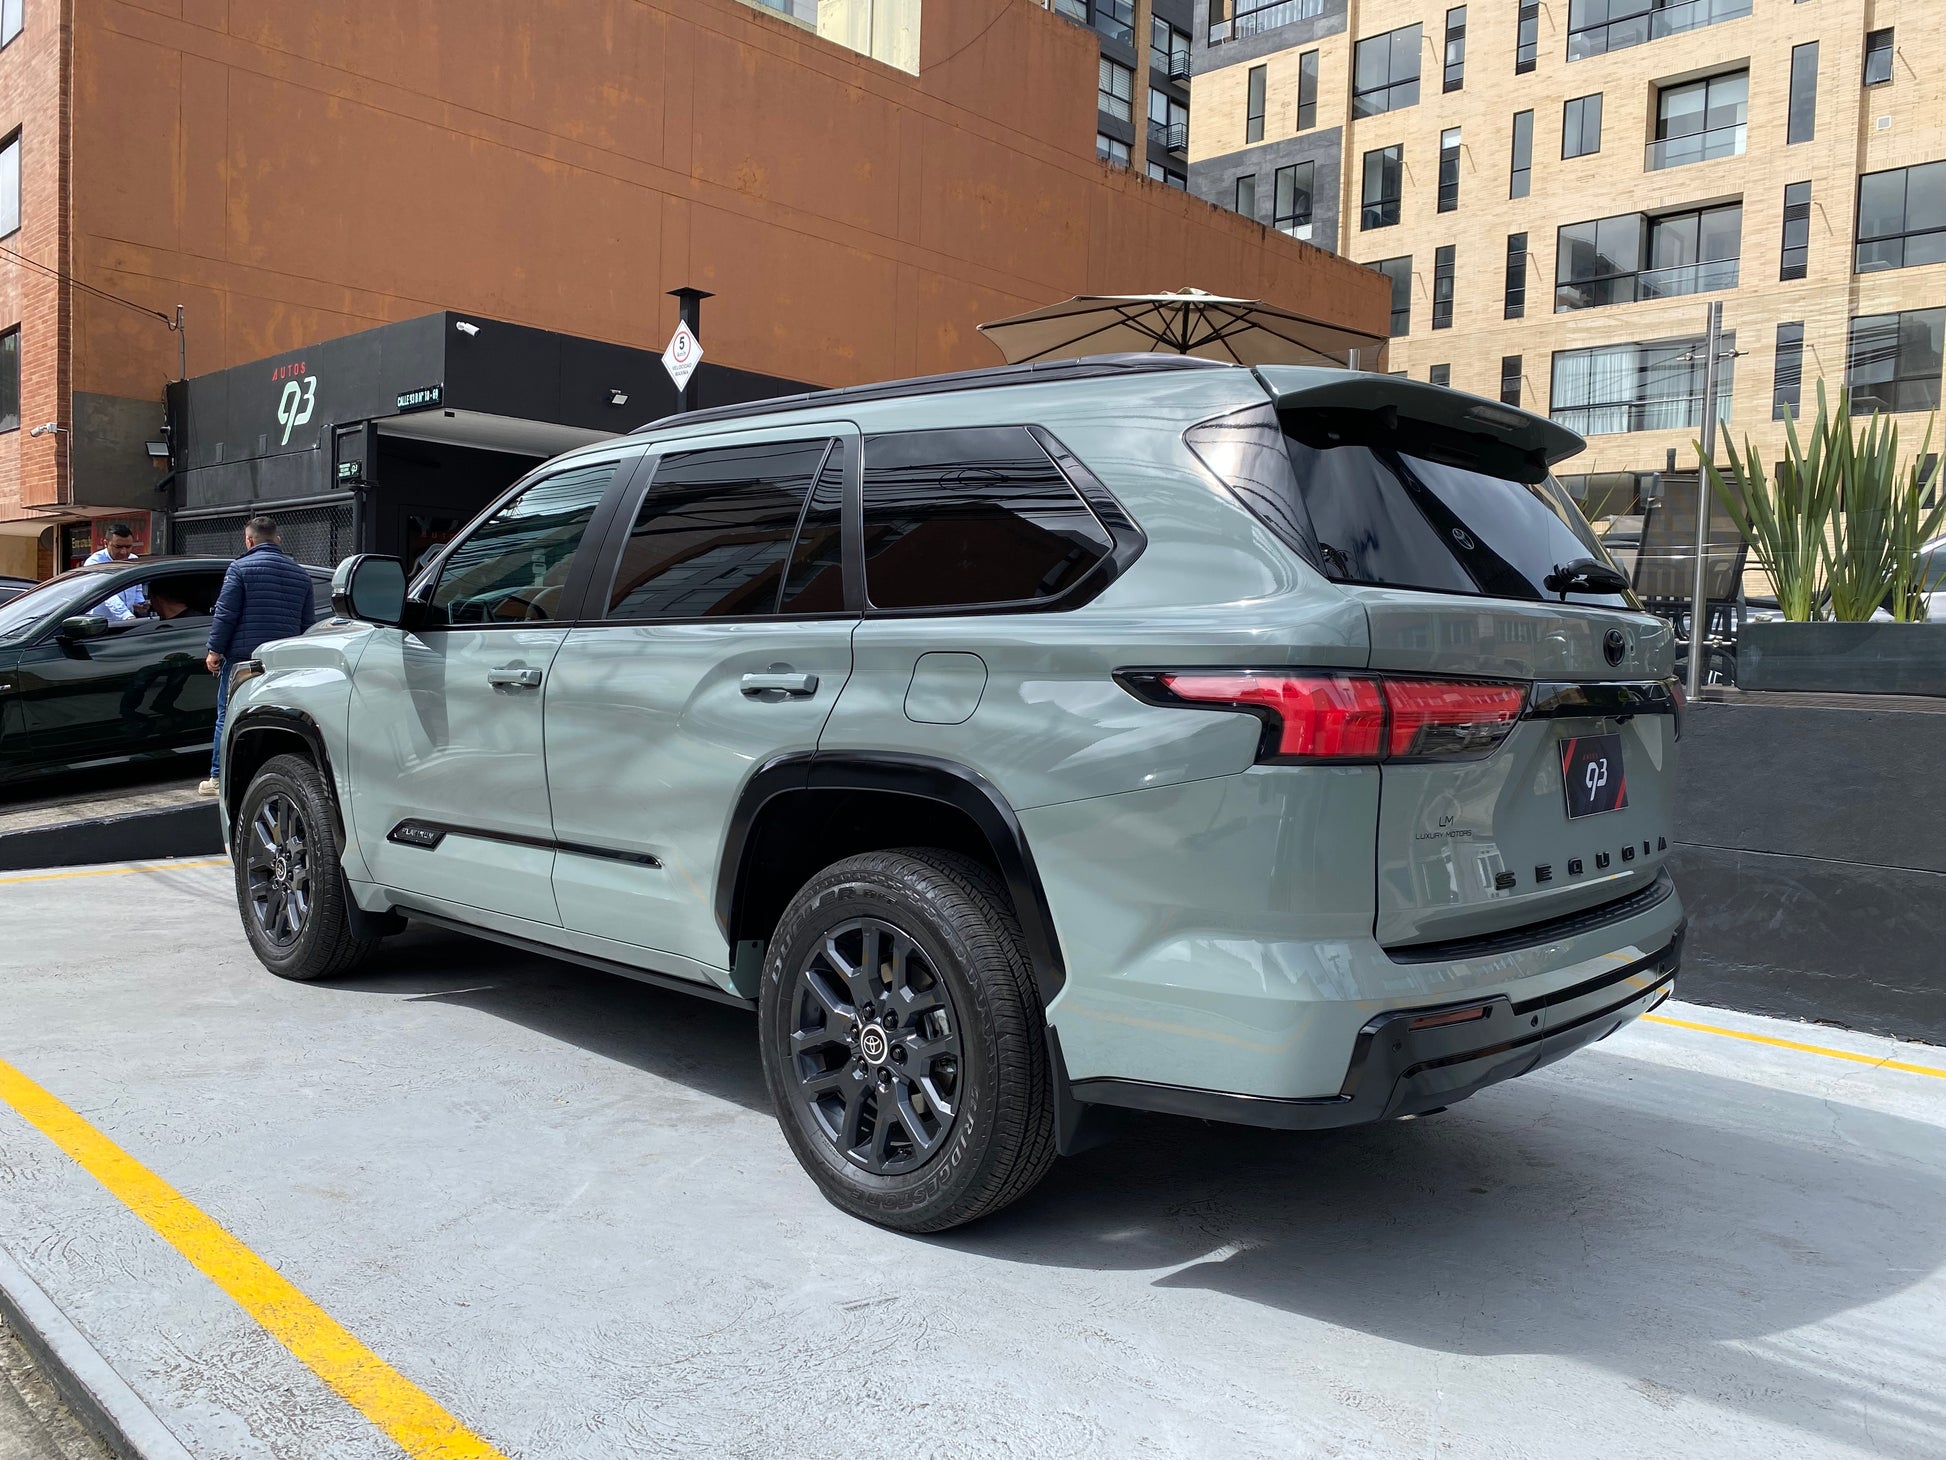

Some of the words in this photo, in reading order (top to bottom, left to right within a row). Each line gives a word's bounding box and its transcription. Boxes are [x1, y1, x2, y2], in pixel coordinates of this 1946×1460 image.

[679, 336, 685, 350] 5
[272, 361, 306, 381] AUTOS
[397, 394, 409, 407] CALLE
[277, 375, 317, 446] 93
[1586, 758, 1608, 802] 93
[1438, 815, 1455, 828] LM
[402, 827, 435, 839] PLATINUM
[1415, 831, 1445, 840] LUXURY
[1446, 829, 1472, 838] MOTORS
[1495, 836, 1667, 891] SEQUOIA
[849, 1086, 979, 1209] BRIDGESTONE
